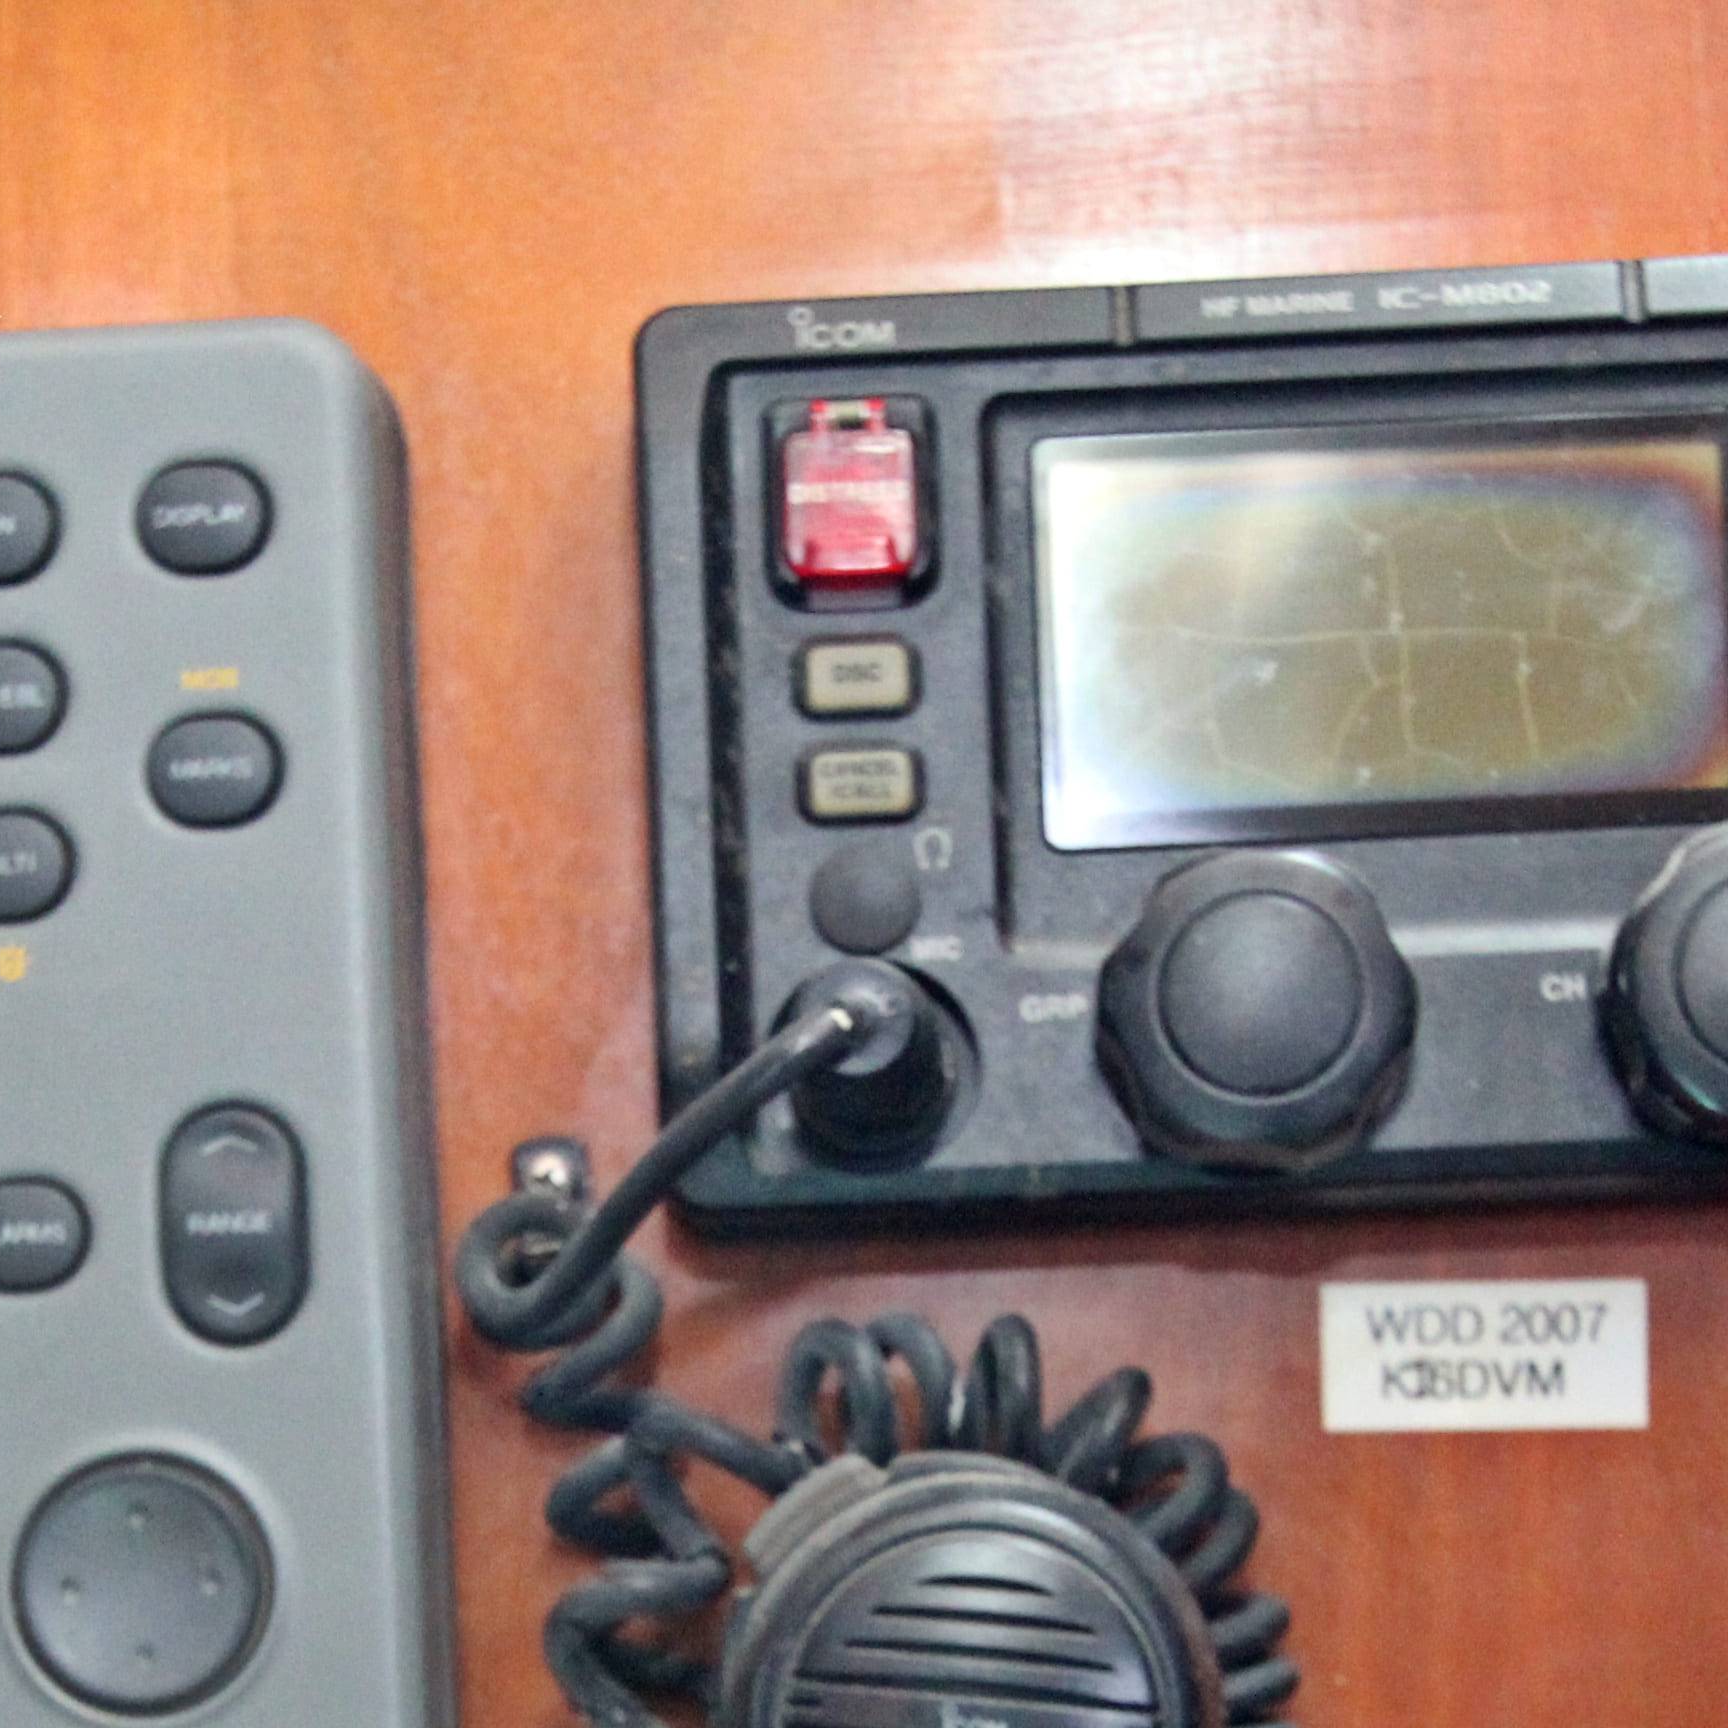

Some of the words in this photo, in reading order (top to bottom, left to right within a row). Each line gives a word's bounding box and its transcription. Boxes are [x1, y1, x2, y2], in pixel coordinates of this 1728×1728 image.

[151, 503, 248, 531] DISPLAY
[1539, 971, 1588, 1002] CH
[1366, 1303, 1486, 1345] WDD
[1499, 1302, 1608, 1345] 2007
